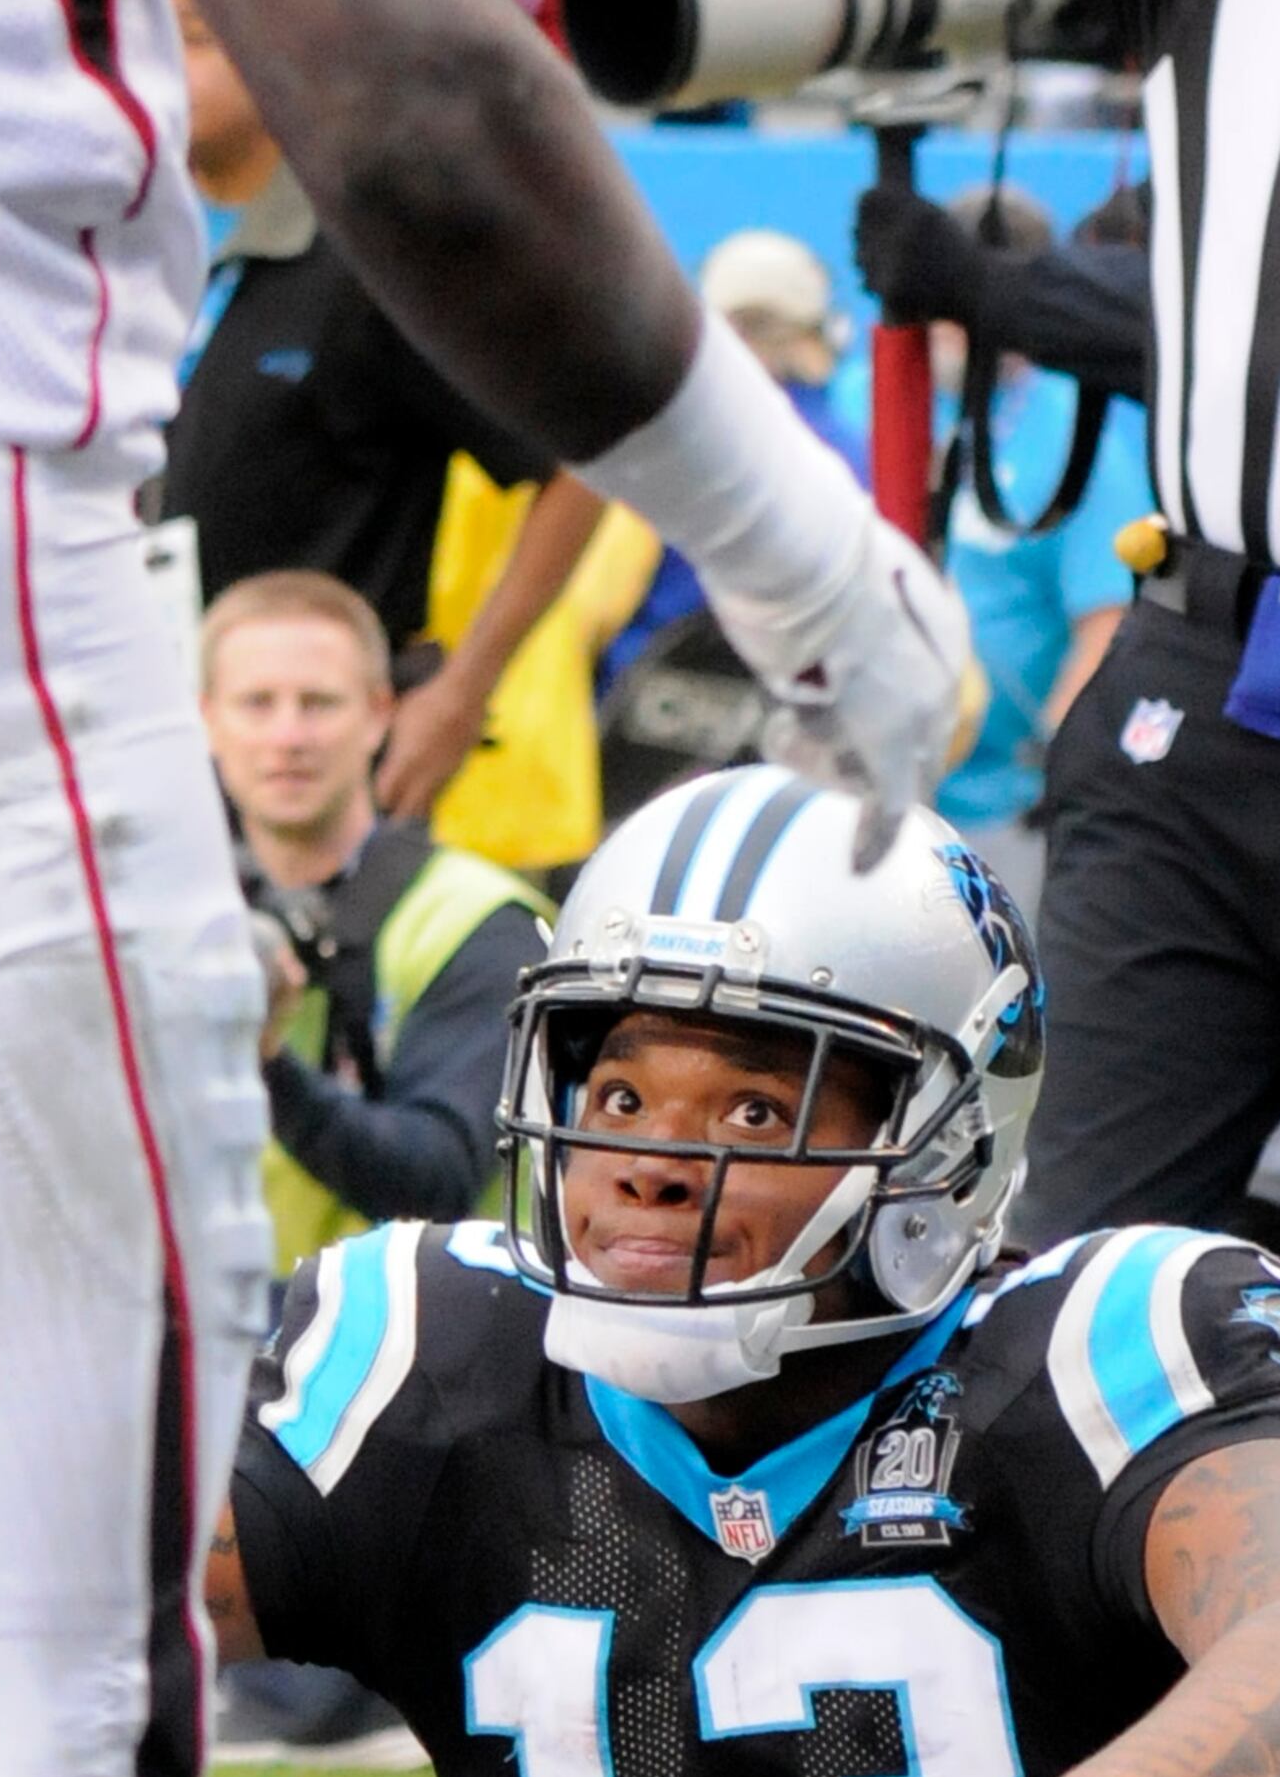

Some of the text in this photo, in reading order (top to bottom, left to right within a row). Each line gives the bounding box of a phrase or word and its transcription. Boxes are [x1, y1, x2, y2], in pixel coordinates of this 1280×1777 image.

[871, 1426, 936, 1489] 20
[868, 1496, 935, 1518] SEASONS
[722, 1522, 768, 1552] NFL
